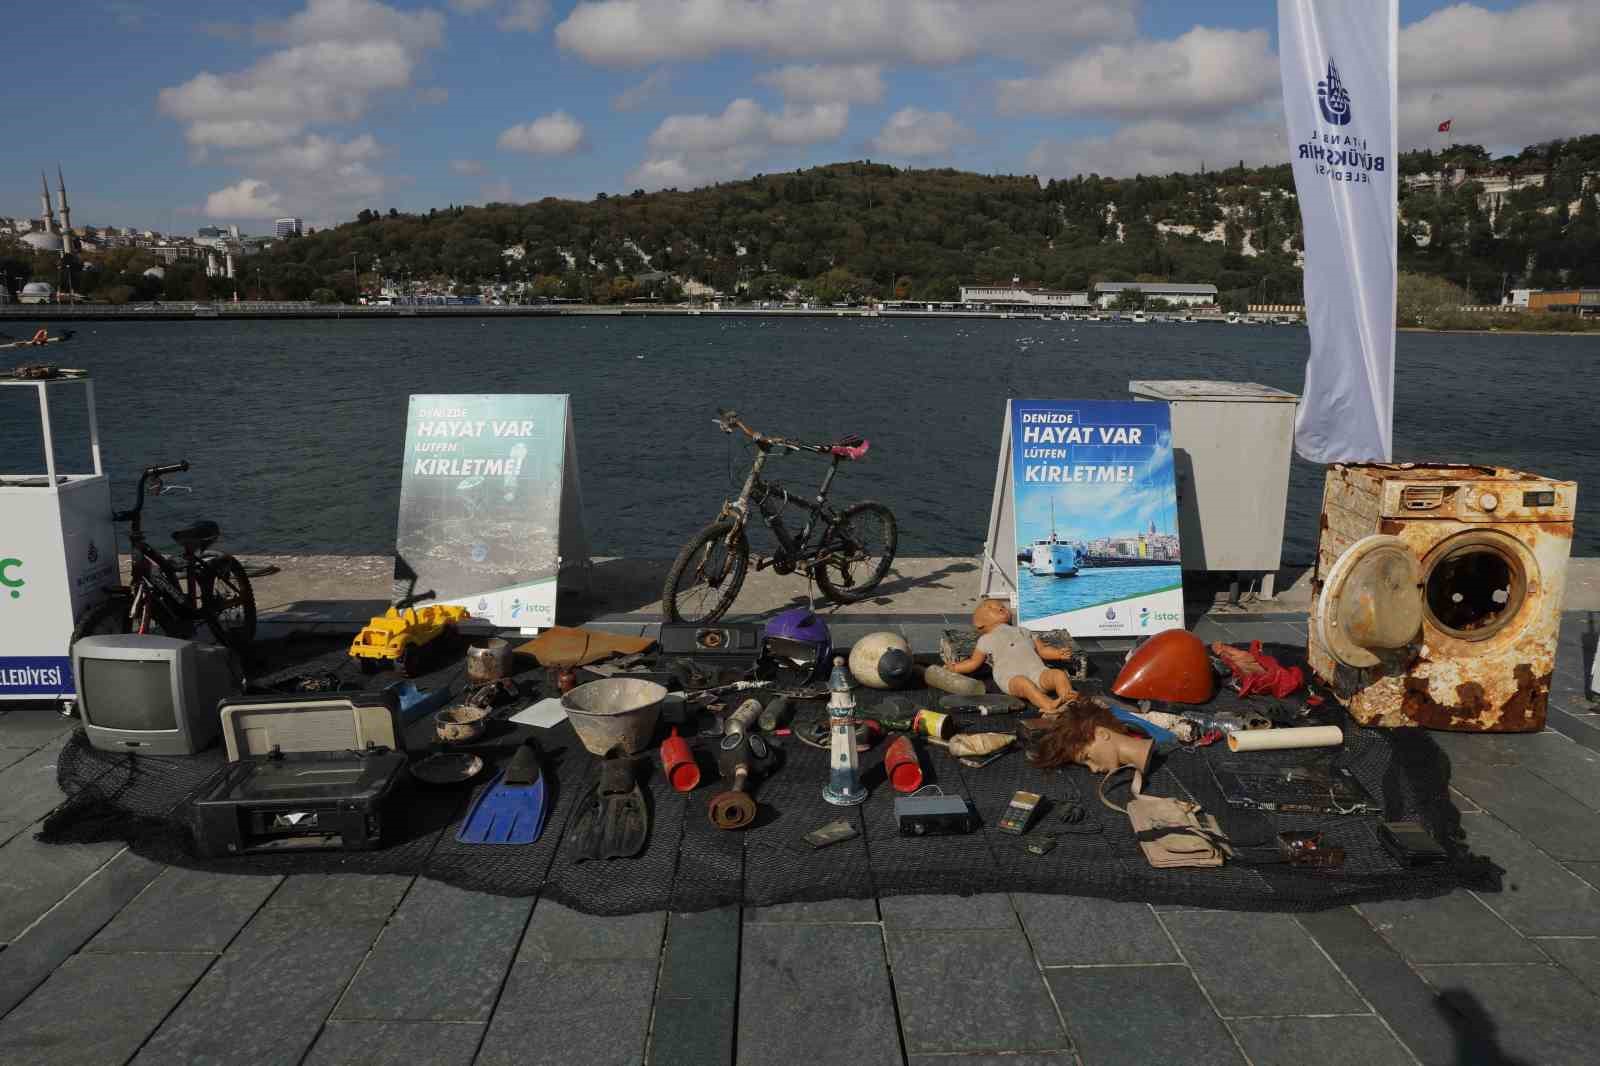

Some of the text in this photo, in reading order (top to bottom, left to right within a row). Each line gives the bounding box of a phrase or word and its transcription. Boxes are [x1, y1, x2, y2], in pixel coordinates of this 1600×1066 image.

[1023, 412, 1073, 424] DENİZDE
[416, 420, 534, 437] HAYAT VAR
[1023, 427, 1142, 444] HAYAT VAR
[1023, 446, 1067, 459] LÜTFEN
[414, 454, 523, 475] KİRLETME!
[1025, 461, 1135, 482] KİRLETME!
